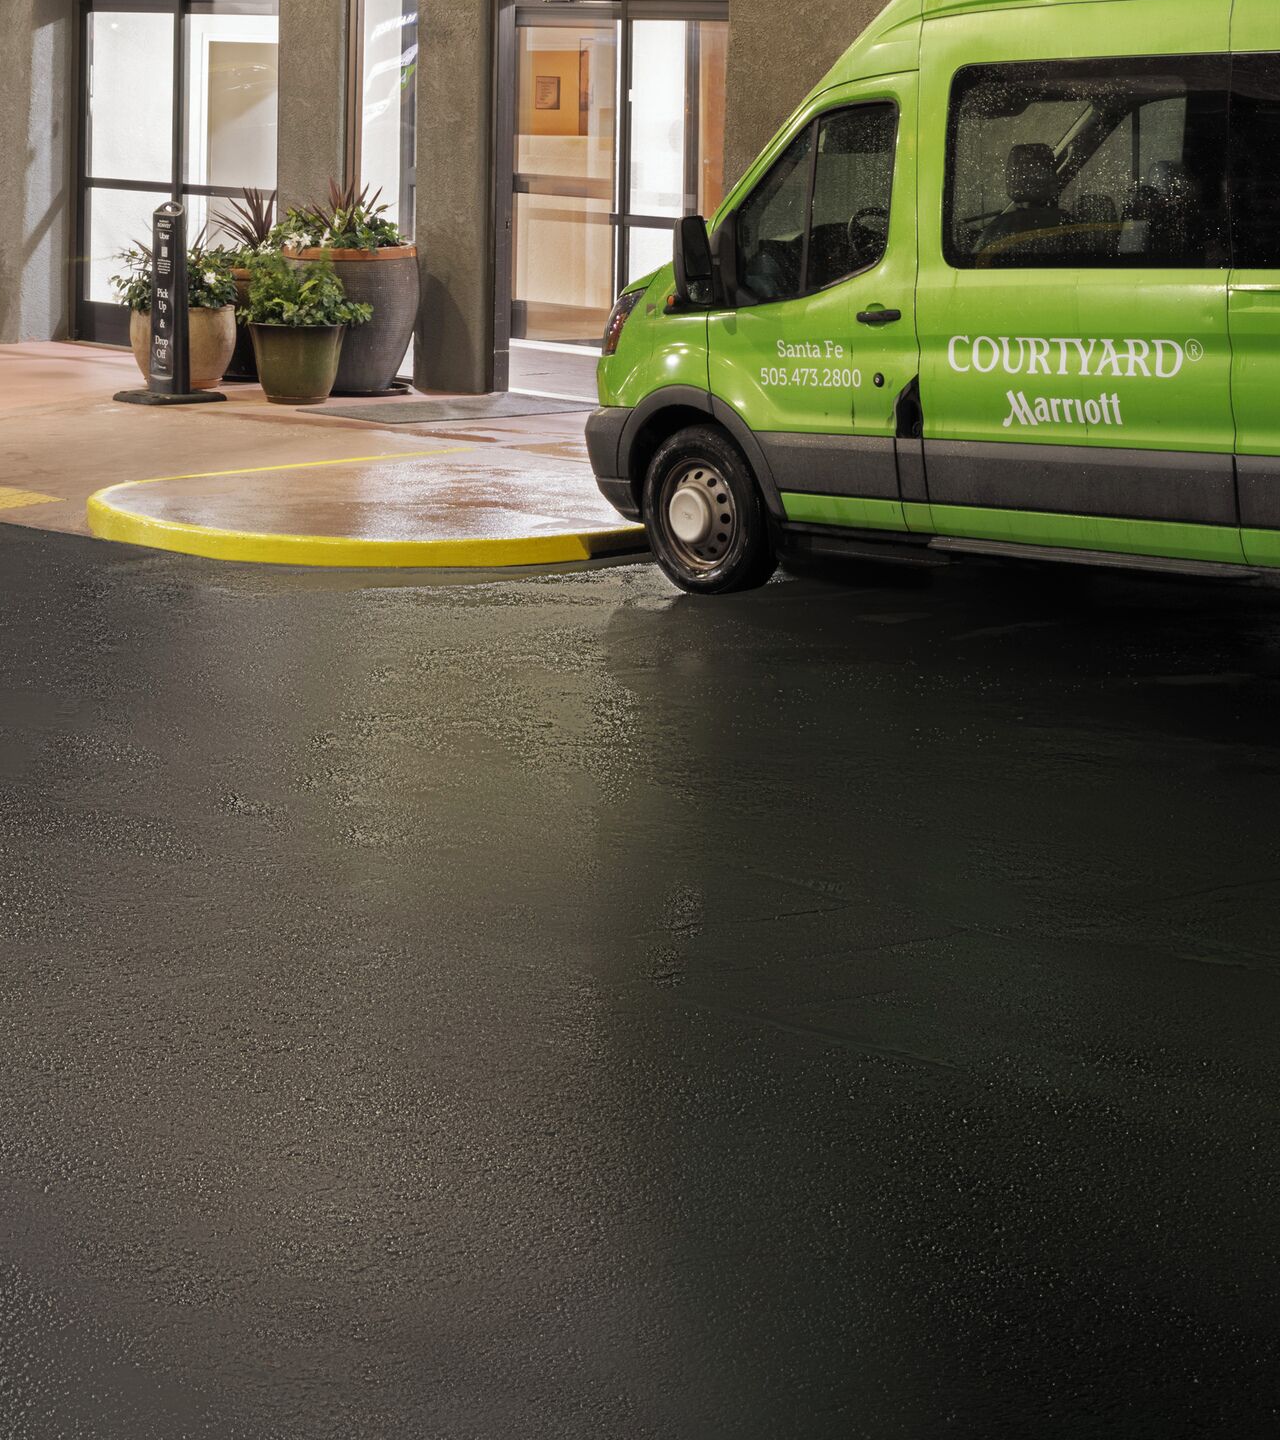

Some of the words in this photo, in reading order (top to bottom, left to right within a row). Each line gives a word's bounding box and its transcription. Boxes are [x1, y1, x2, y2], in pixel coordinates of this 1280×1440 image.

[156, 287, 169, 299] Pick
[158, 300, 167, 313] Up
[159, 318, 166, 329] &
[154, 335, 169, 348] Drop
[156, 348, 167, 359] Off
[776, 339, 822, 358] Santa
[823, 340, 844, 359] Fe
[760, 367, 862, 388] 505.473.2800
[1002, 389, 1123, 428] Marriott
